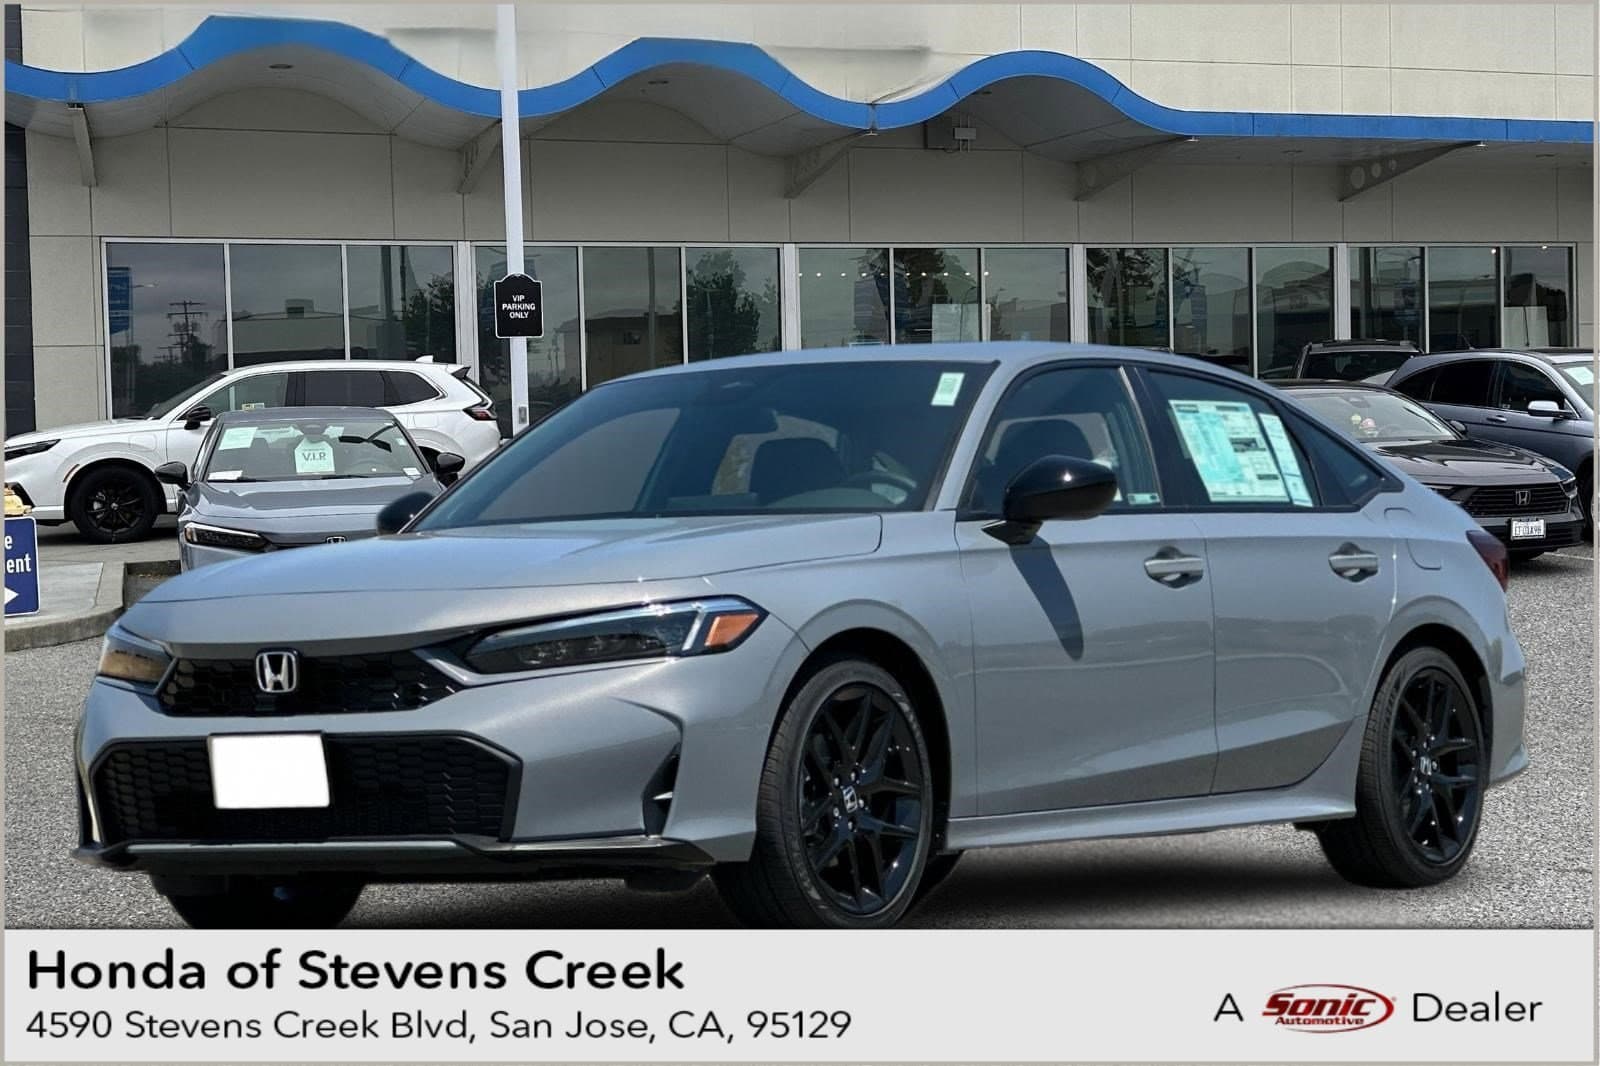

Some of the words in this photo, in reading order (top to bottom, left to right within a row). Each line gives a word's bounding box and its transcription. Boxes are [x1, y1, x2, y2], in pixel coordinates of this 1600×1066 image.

[512, 294, 525, 302] VIP
[502, 303, 536, 311] PARKING
[509, 311, 529, 319] ONLY
